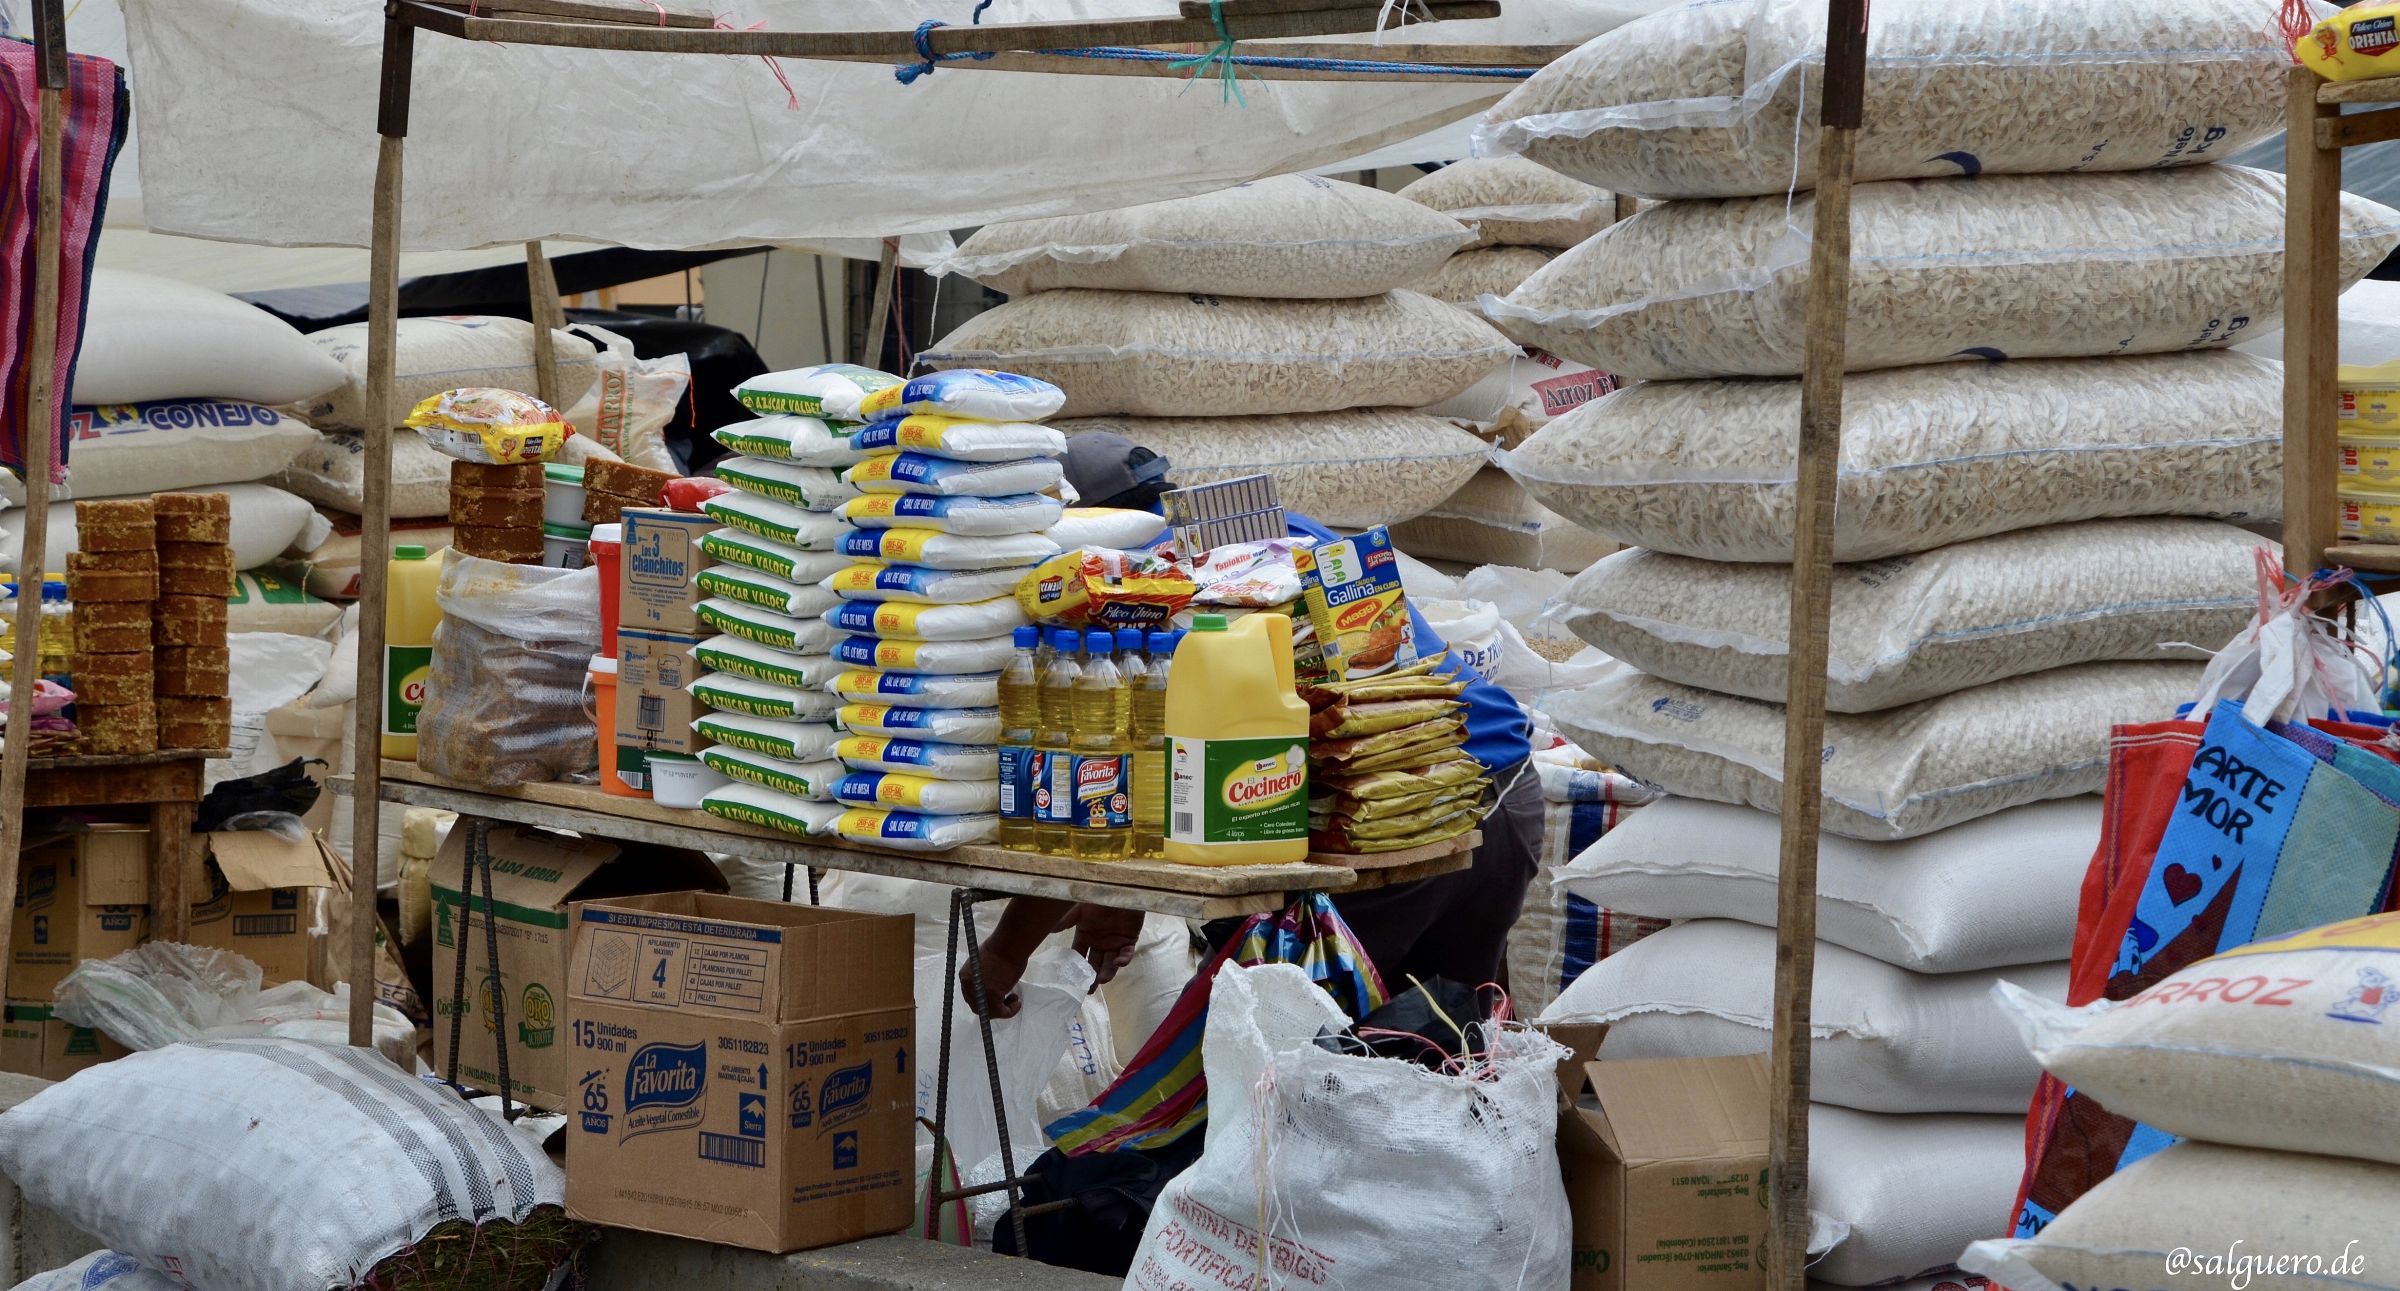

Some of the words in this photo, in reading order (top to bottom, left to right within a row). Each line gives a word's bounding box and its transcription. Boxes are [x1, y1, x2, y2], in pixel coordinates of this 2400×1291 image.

[2373, 19, 2393, 29] Chino
[2348, 30, 2400, 49] ORIENTAL
[2166, 126, 2195, 159] Neto
[2186, 127, 2226, 155] kg
[2211, 316, 2249, 343] kg
[1546, 383, 1597, 408] Arroz
[146, 403, 280, 431] CONEJO
[863, 431, 872, 443] SAL
[903, 499, 913, 509] SAL
[641, 544, 651, 556] Los
[652, 533, 660, 557] 3
[848, 539, 857, 550] SAL
[632, 554, 684, 576] Chanchitos
[718, 545, 753, 564] AZÚCAR
[756, 556, 790, 578] VALDEZ
[1372, 552, 1392, 561] secreto
[1379, 556, 1394, 564] sabor
[1355, 578, 1368, 586] CALDO
[1327, 581, 1375, 605] Gallina
[1382, 580, 1399, 590] CUBO
[752, 591, 786, 613] VALDEZ
[653, 608, 660, 619] kg
[1104, 605, 1130, 618] Fideo
[1131, 606, 1163, 619] Chino
[1340, 601, 1377, 627] Maggi
[716, 617, 753, 641] AZÚCAR
[756, 631, 794, 649] VALDEZ
[1463, 650, 1485, 666] DE
[718, 656, 756, 679] AZÚCAR
[759, 668, 800, 688] VALDEZ
[754, 703, 792, 718] VALDEZ
[716, 731, 756, 752] AZÚCAR
[758, 739, 794, 759] VALDEZ
[891, 745, 900, 756] SAL
[908, 747, 920, 758] MESA
[726, 763, 763, 785] AZÚCAR
[1081, 765, 1114, 783] Favorita
[843, 783, 851, 793] SAL
[857, 784, 870, 795] MESA
[1229, 771, 1301, 803] Cocinero
[724, 805, 765, 827] AZÚCAR
[1090, 804, 1107, 817] 65
[1239, 812, 1261, 822] experto
[1269, 804, 1290, 814] comidas
[2184, 778, 2254, 845] MOR
[889, 820, 898, 831] SAL
[492, 859, 524, 875] LADO
[521, 866, 563, 884] ARRIBA
[608, 914, 616, 923] SI
[617, 914, 637, 925] ESTA
[638, 918, 680, 930] IMPRESION
[682, 922, 702, 933] ESTA
[704, 925, 757, 940] DETERIORADA
[703, 948, 718, 958] CAJAS
[719, 950, 728, 959] POR
[729, 951, 750, 961] PLANCHA
[652, 958, 667, 988] 4
[702, 962, 726, 973] PLANCHAS
[727, 966, 736, 975] POR
[736, 967, 752, 977] PALLET
[700, 978, 714, 987] CAJAS
[715, 980, 724, 989] POR
[724, 982, 742, 991] PALLET
[2121, 975, 2316, 1008] ARROZ
[651, 991, 666, 1000] CAJAS
[526, 998, 550, 1021] ORO
[572, 1018, 595, 1049] 15
[597, 1022, 637, 1039] Unidades
[597, 1037, 613, 1051] 900
[615, 1041, 626, 1053] ml
[809, 1038, 846, 1051] Unidades
[645, 1053, 657, 1069] La
[786, 1042, 807, 1068] 15
[809, 1053, 823, 1066] 900
[825, 1052, 836, 1063] ml
[464, 1066, 495, 1084] UNIDADES
[631, 1059, 696, 1102] Favorita
[584, 1083, 608, 1112] 65
[823, 1073, 866, 1110] Favorita
[793, 1091, 810, 1112] 65
[584, 1115, 606, 1128] AÑOS
[628, 1115, 646, 1130] Aceite
[646, 1111, 667, 1128] Vegetal
[667, 1107, 700, 1122] Comestible
[744, 1121, 761, 1131] Sierra
[1735, 1187, 1748, 1196] Reg.
[1656, 1238, 1696, 1249] (Colombia)
[1156, 1217, 1270, 1291] FORTIFICA
[1638, 1252, 1673, 1264] (Ecuador)
[1735, 1262, 1748, 1271] Reg.
